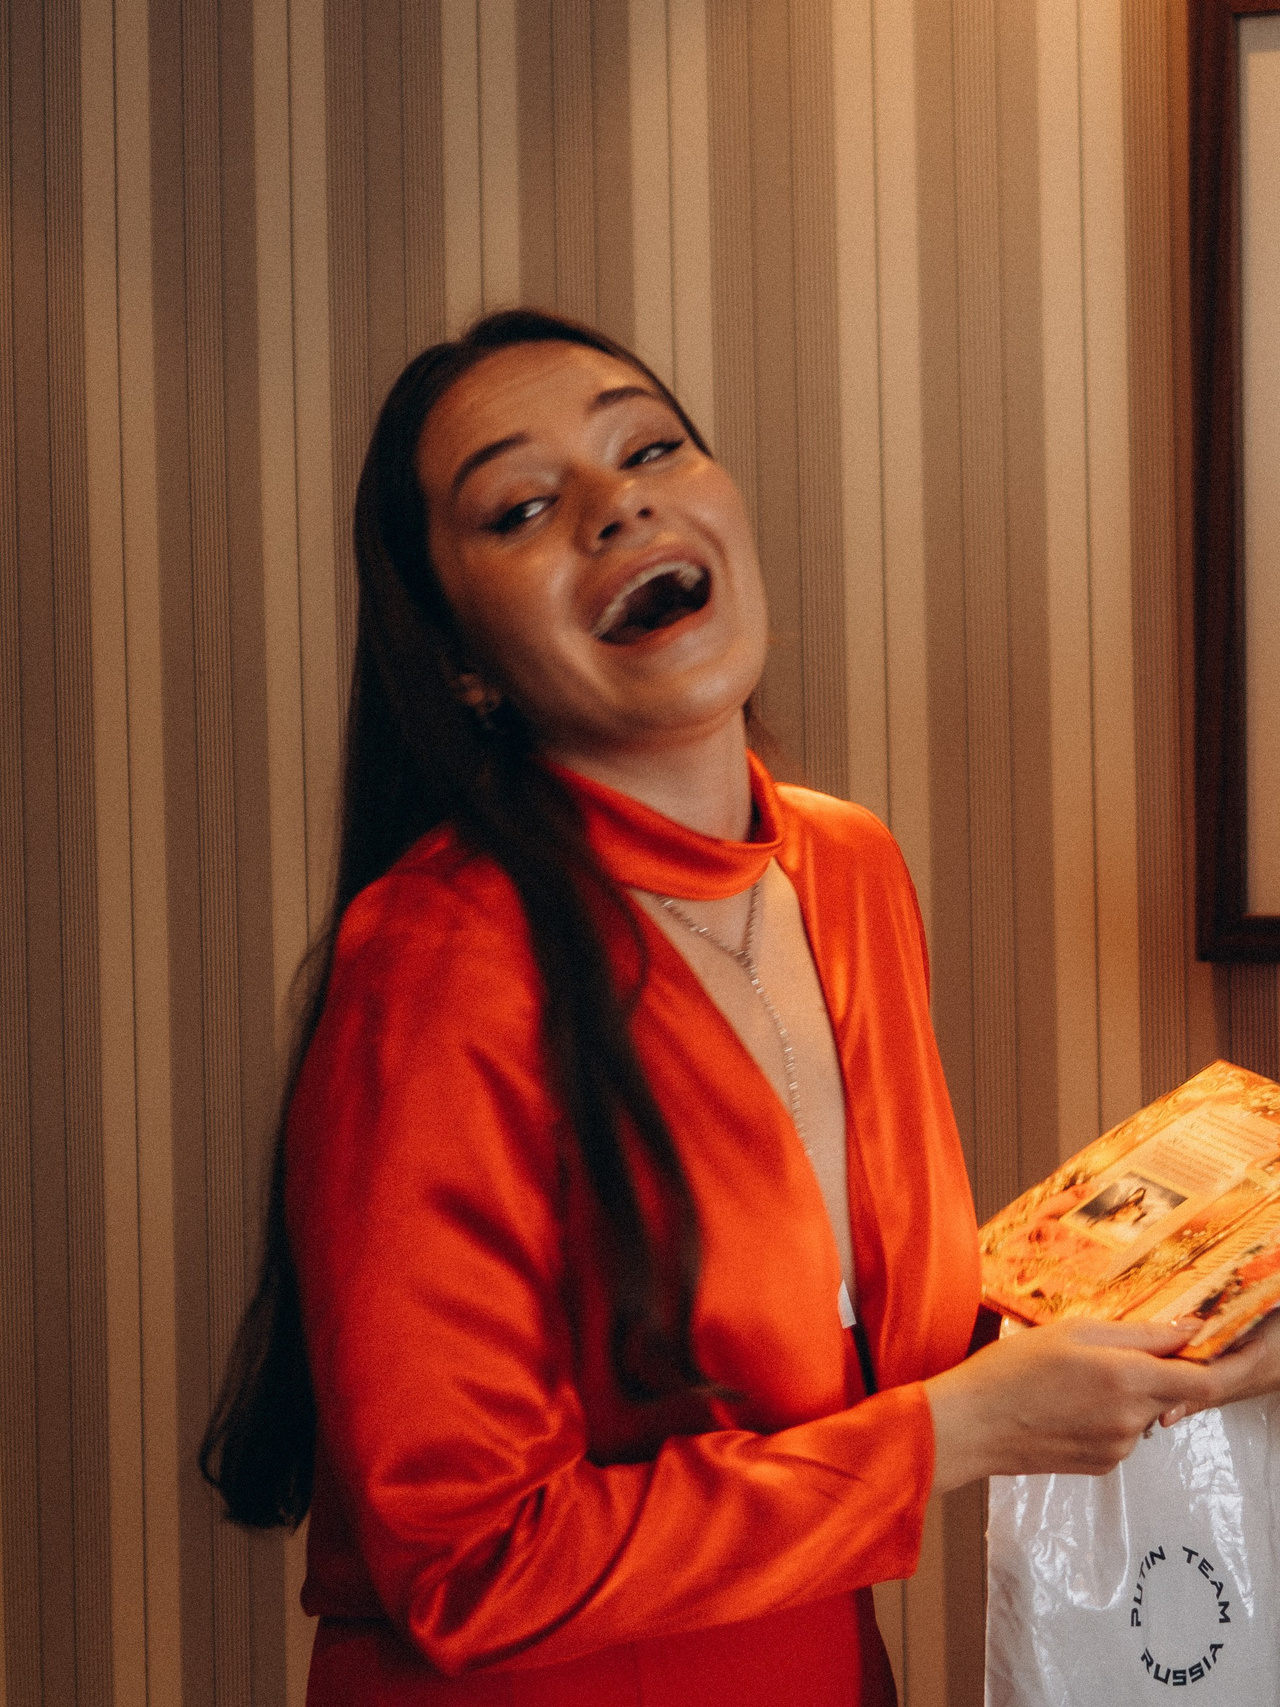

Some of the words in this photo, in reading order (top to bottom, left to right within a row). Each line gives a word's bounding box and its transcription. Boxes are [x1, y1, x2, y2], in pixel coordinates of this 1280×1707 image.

[1131, 1545, 1166, 1627] PUTIN
[1182, 1546, 1231, 1623] TEAM
[1140, 1643, 1224, 1686] RUSSIA
